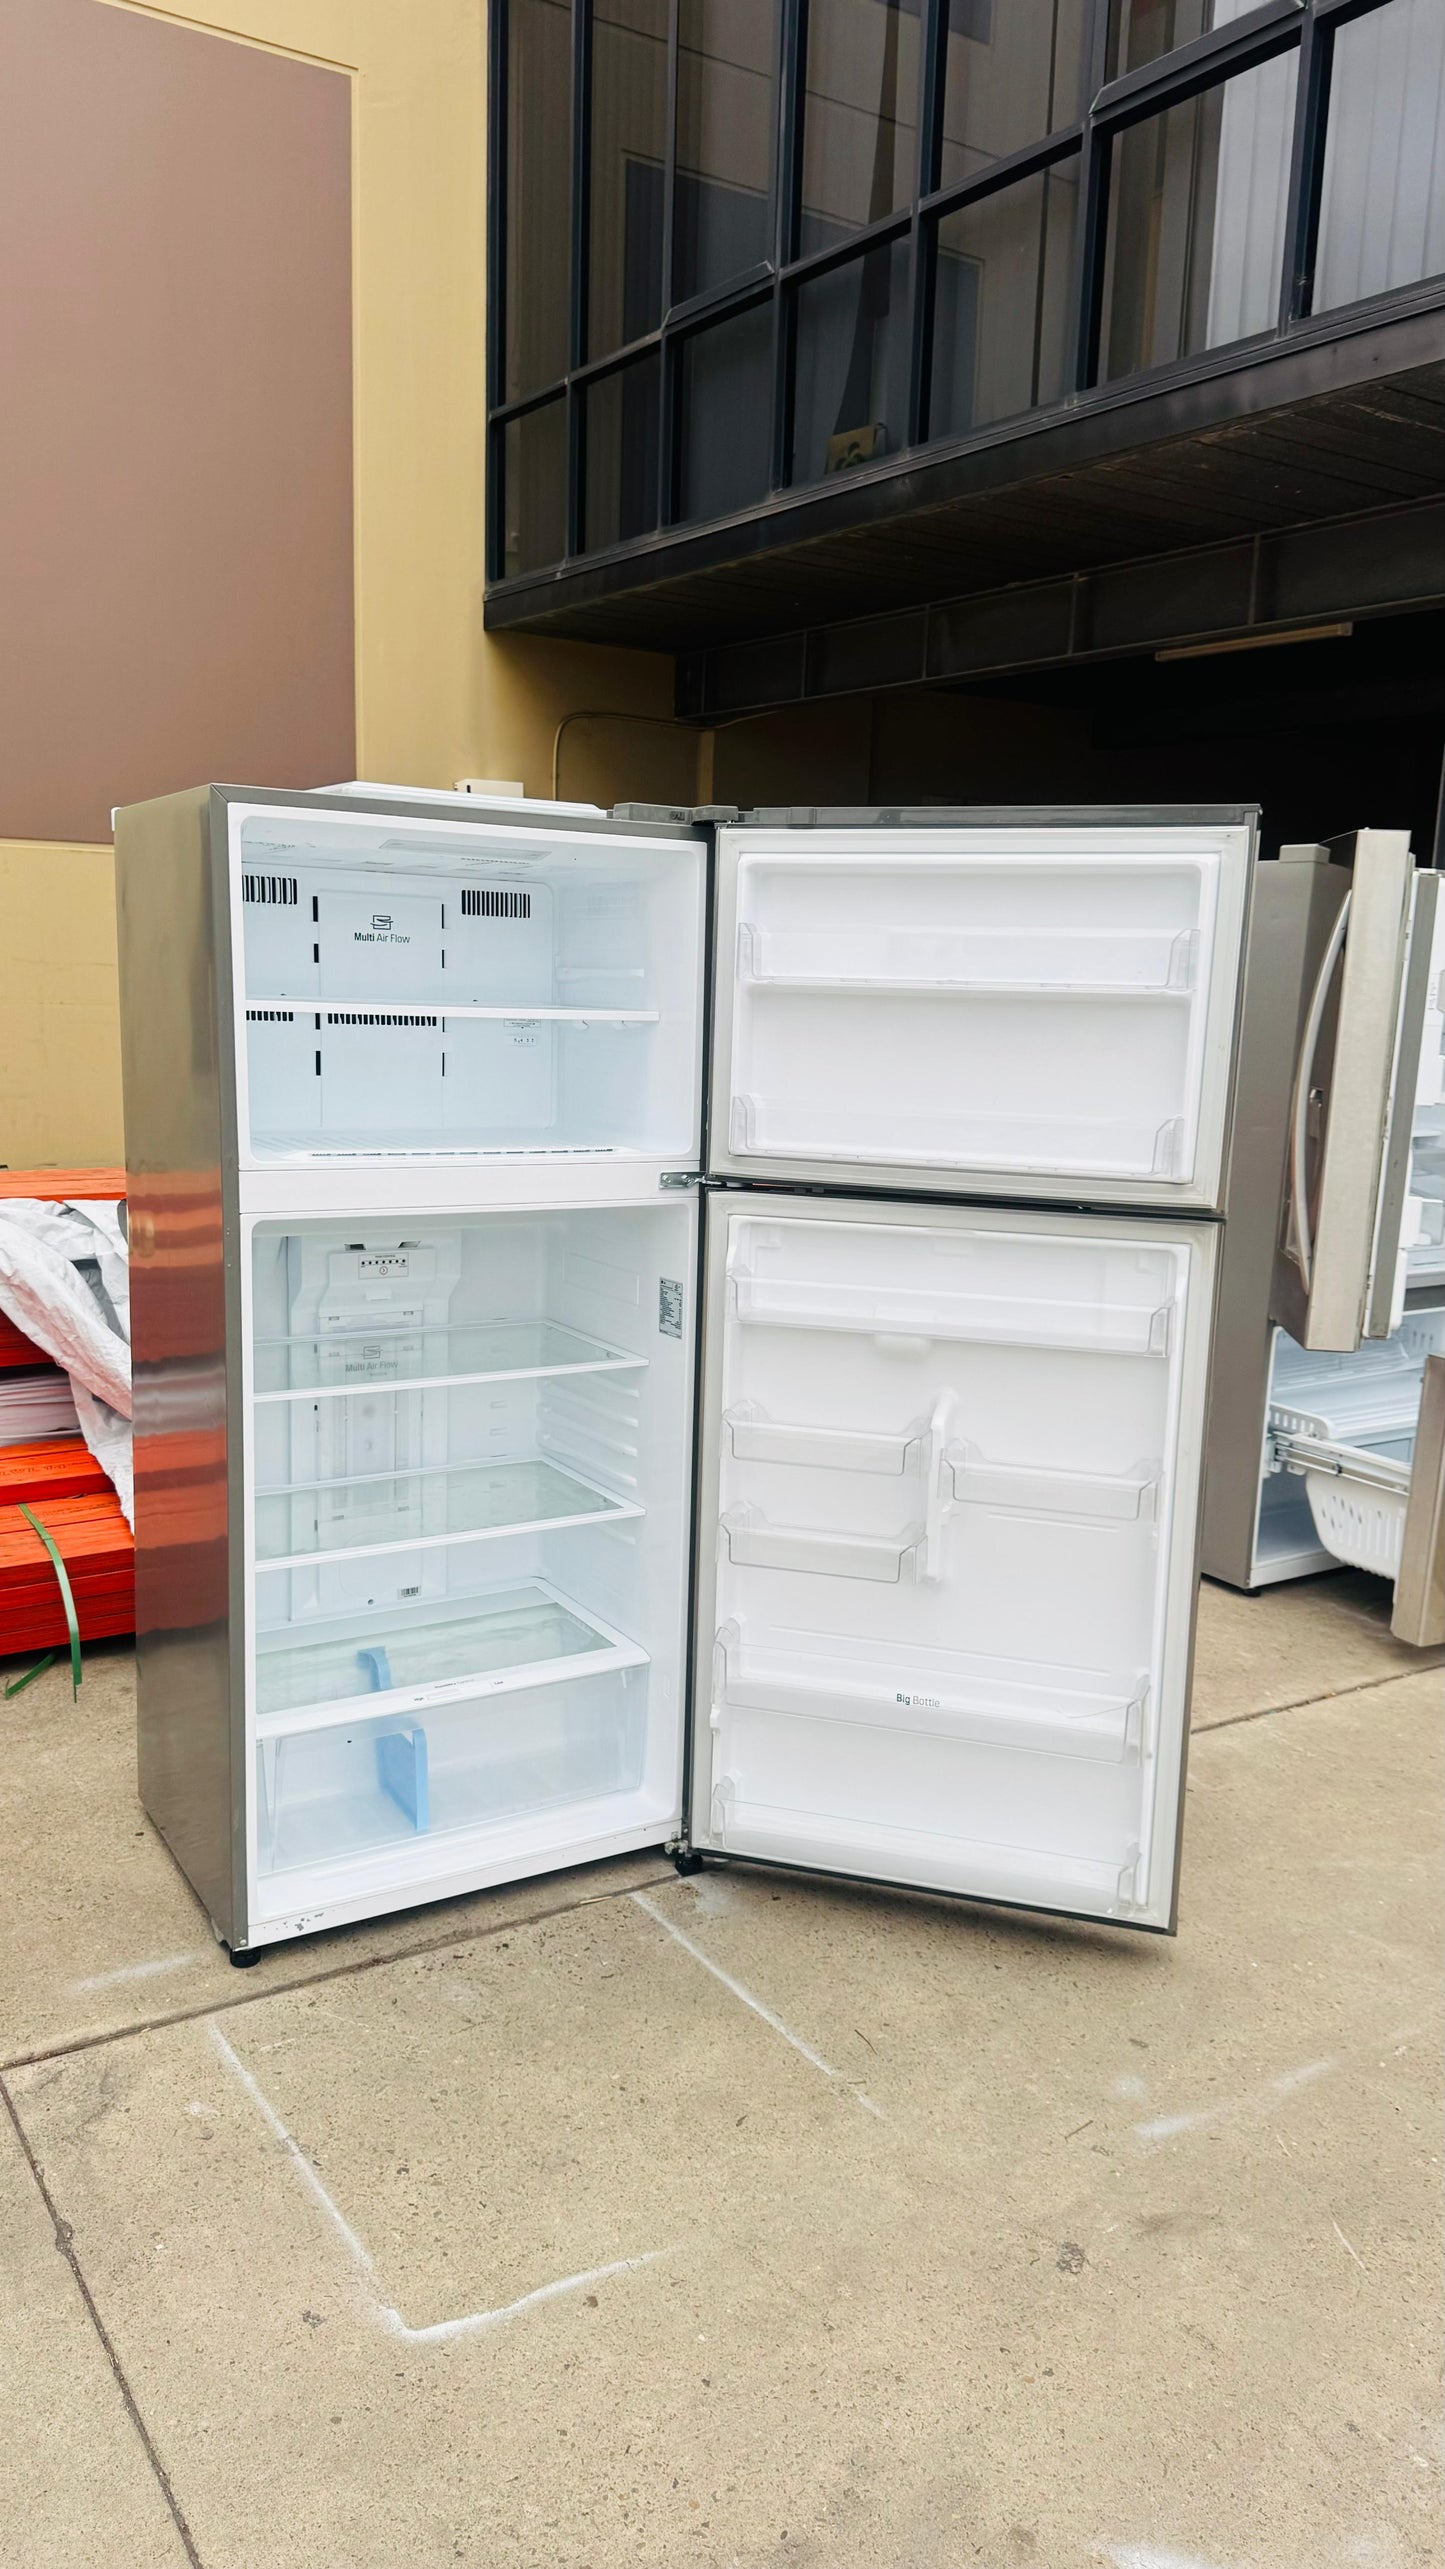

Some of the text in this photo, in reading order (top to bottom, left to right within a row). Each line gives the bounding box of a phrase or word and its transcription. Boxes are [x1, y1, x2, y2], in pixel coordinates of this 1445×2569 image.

[354, 932, 411, 943] Multi Air Flow
[896, 1693, 941, 1708] Big Bottle
